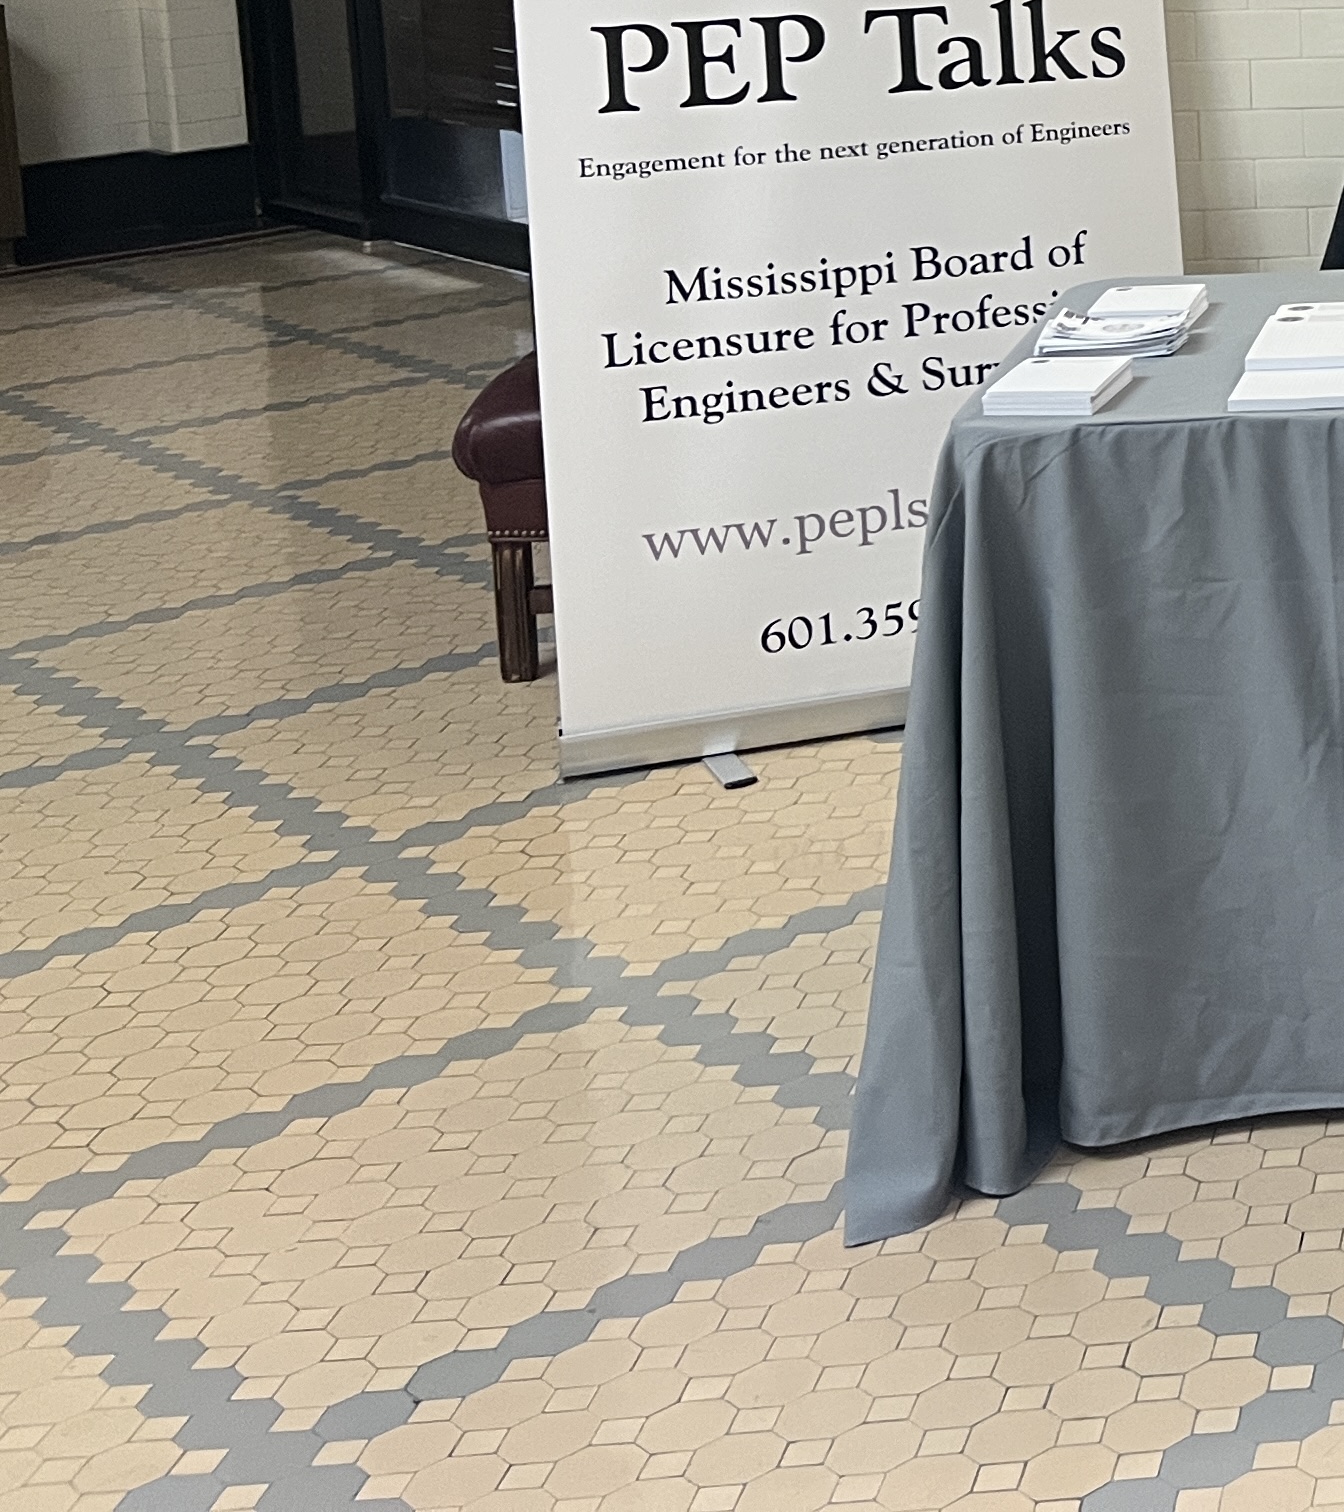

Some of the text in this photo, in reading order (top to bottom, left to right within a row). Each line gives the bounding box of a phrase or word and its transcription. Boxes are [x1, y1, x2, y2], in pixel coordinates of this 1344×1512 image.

[590, 14, 826, 115] PEP
[578, 122, 1131, 181] Engagement for the next generation of Engineers
[663, 229, 1088, 305] Mississippi Board of
[601, 327, 815, 369] Licensure
[829, 309, 889, 346] for
[638, 356, 1001, 425] Engineers & Sur
[641, 488, 929, 561] www.pepls
